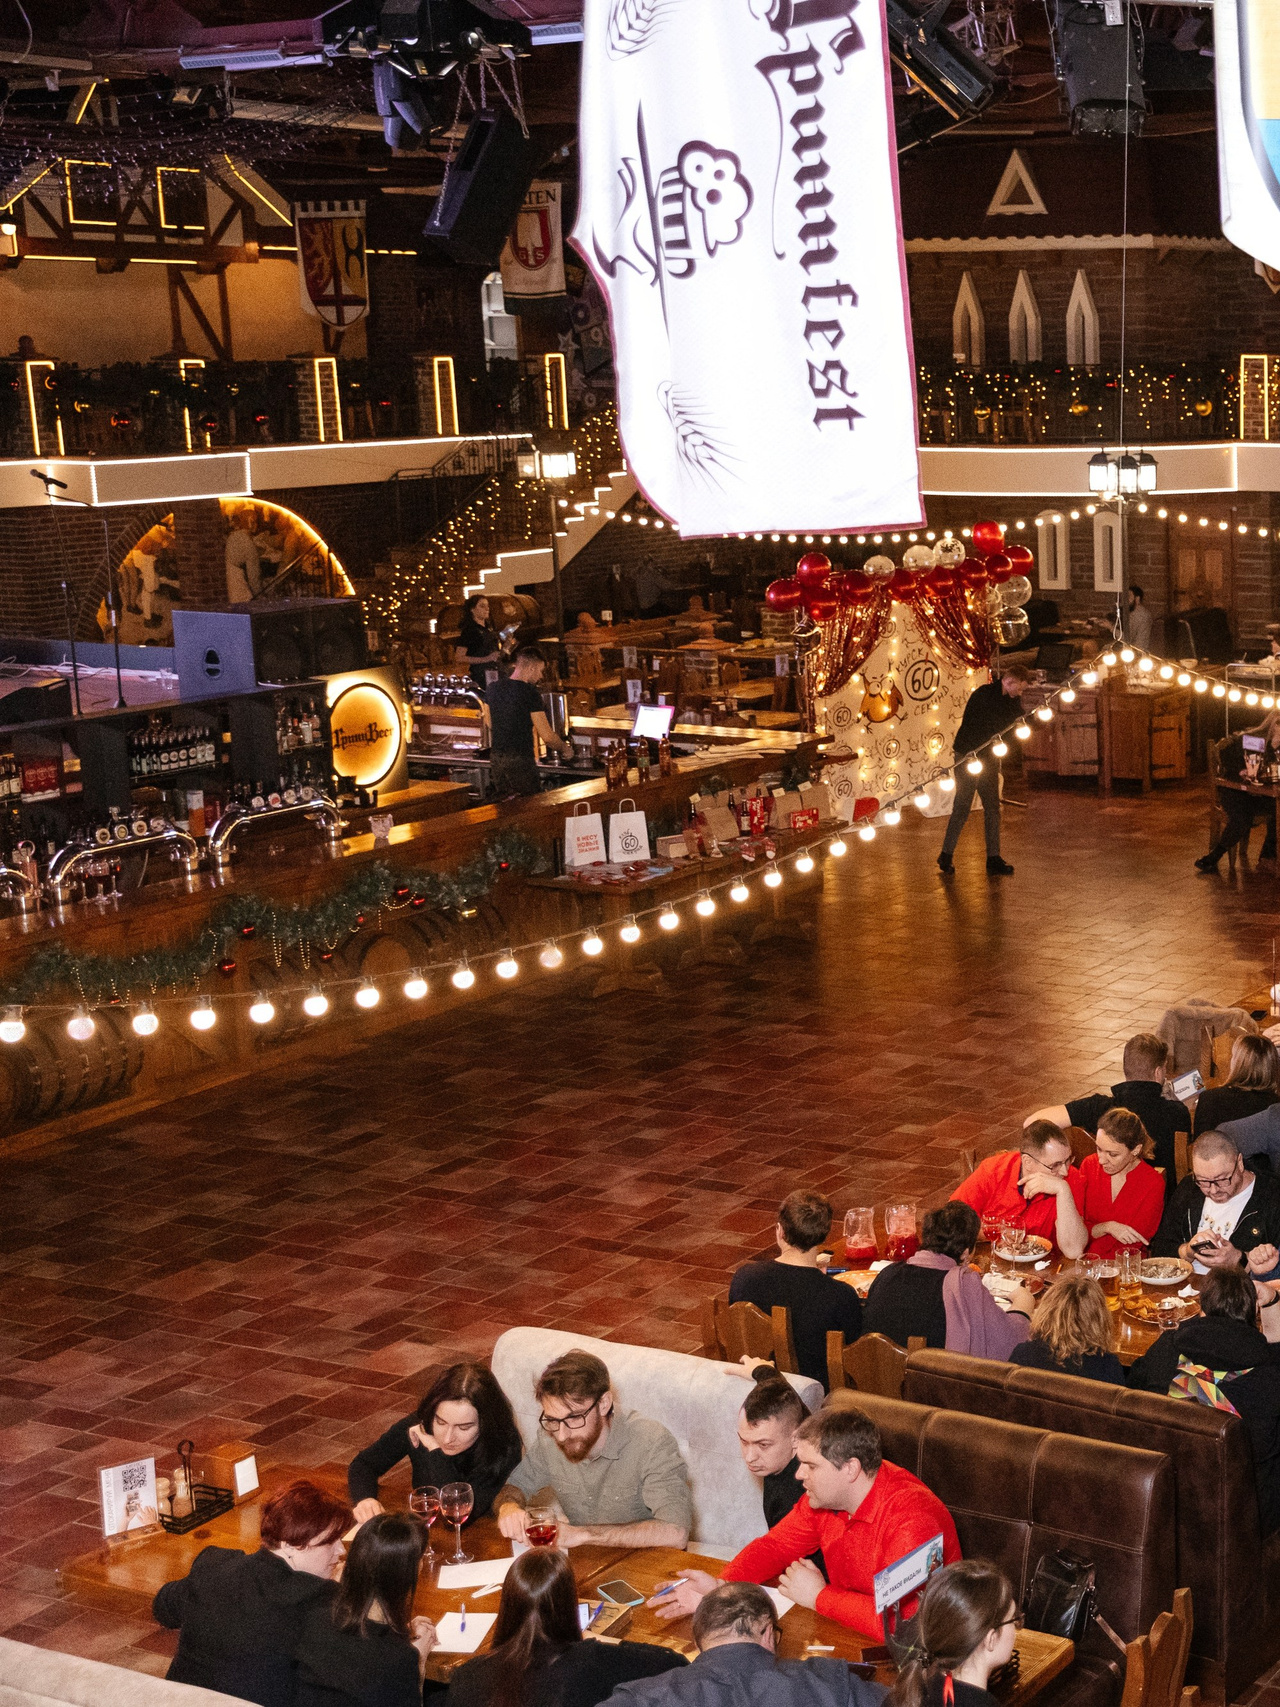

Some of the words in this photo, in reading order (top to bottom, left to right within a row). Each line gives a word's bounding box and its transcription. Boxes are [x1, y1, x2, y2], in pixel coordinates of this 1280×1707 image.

[524, 188, 557, 204] TEN
[911, 666, 934, 694] 60
[836, 709, 849, 724] 60
[838, 782, 849, 796] 60
[624, 837, 636, 849] 60
